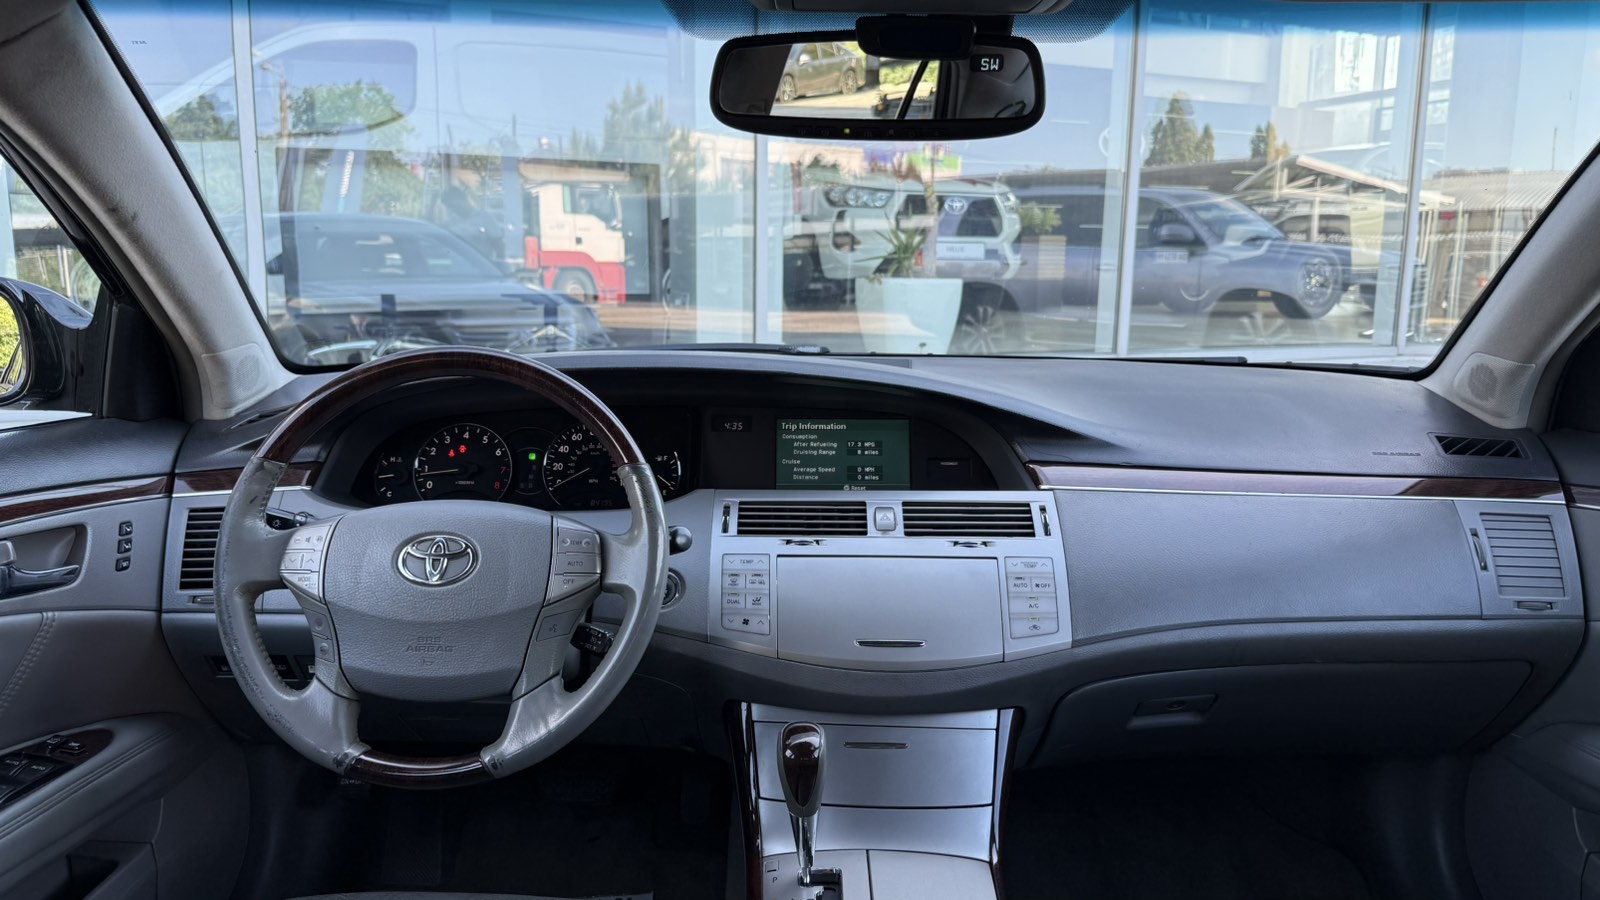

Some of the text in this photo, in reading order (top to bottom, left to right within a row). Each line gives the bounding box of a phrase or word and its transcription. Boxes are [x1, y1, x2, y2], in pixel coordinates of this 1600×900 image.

[981, 58, 999, 71] SW
[725, 422, 743, 430] 4:35
[781, 422, 847, 431] Trip Information
[444, 436, 451, 444] 3
[482, 436, 488, 444] 5
[571, 433, 583, 441] 60
[495, 448, 502, 456] 6
[558, 445, 569, 453] 40
[500, 466, 506, 474] 7
[552, 462, 563, 470] 20
[426, 481, 433, 489] 0
[405, 645, 453, 653] AIRBAG
